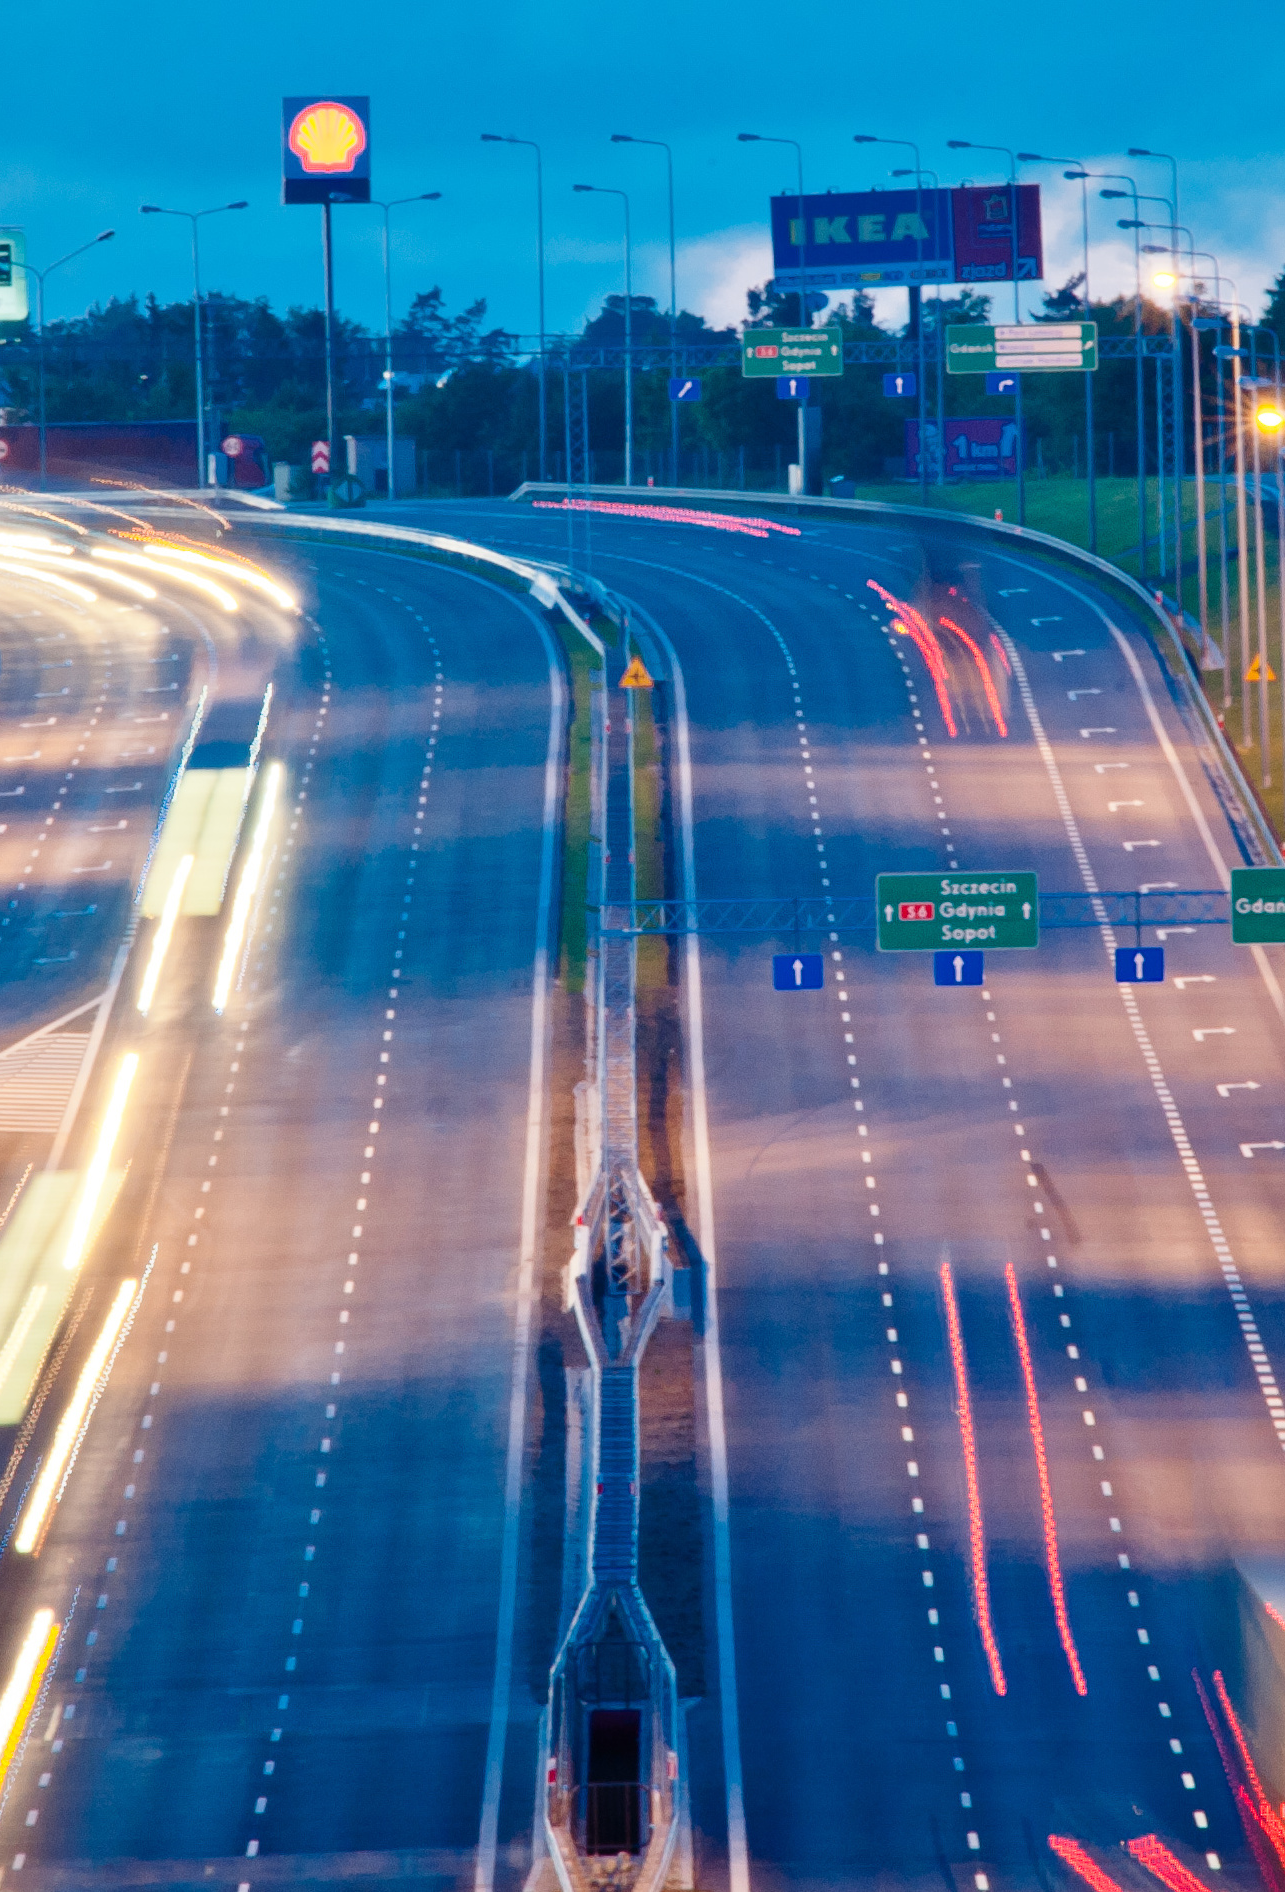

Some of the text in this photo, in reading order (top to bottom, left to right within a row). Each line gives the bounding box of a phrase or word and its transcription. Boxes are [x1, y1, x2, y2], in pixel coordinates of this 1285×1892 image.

[789, 213, 930, 246] IKEA
[940, 878, 1017, 895] Szczecin
[939, 901, 1006, 921] Gdynia
[941, 924, 997, 944] Sopot
